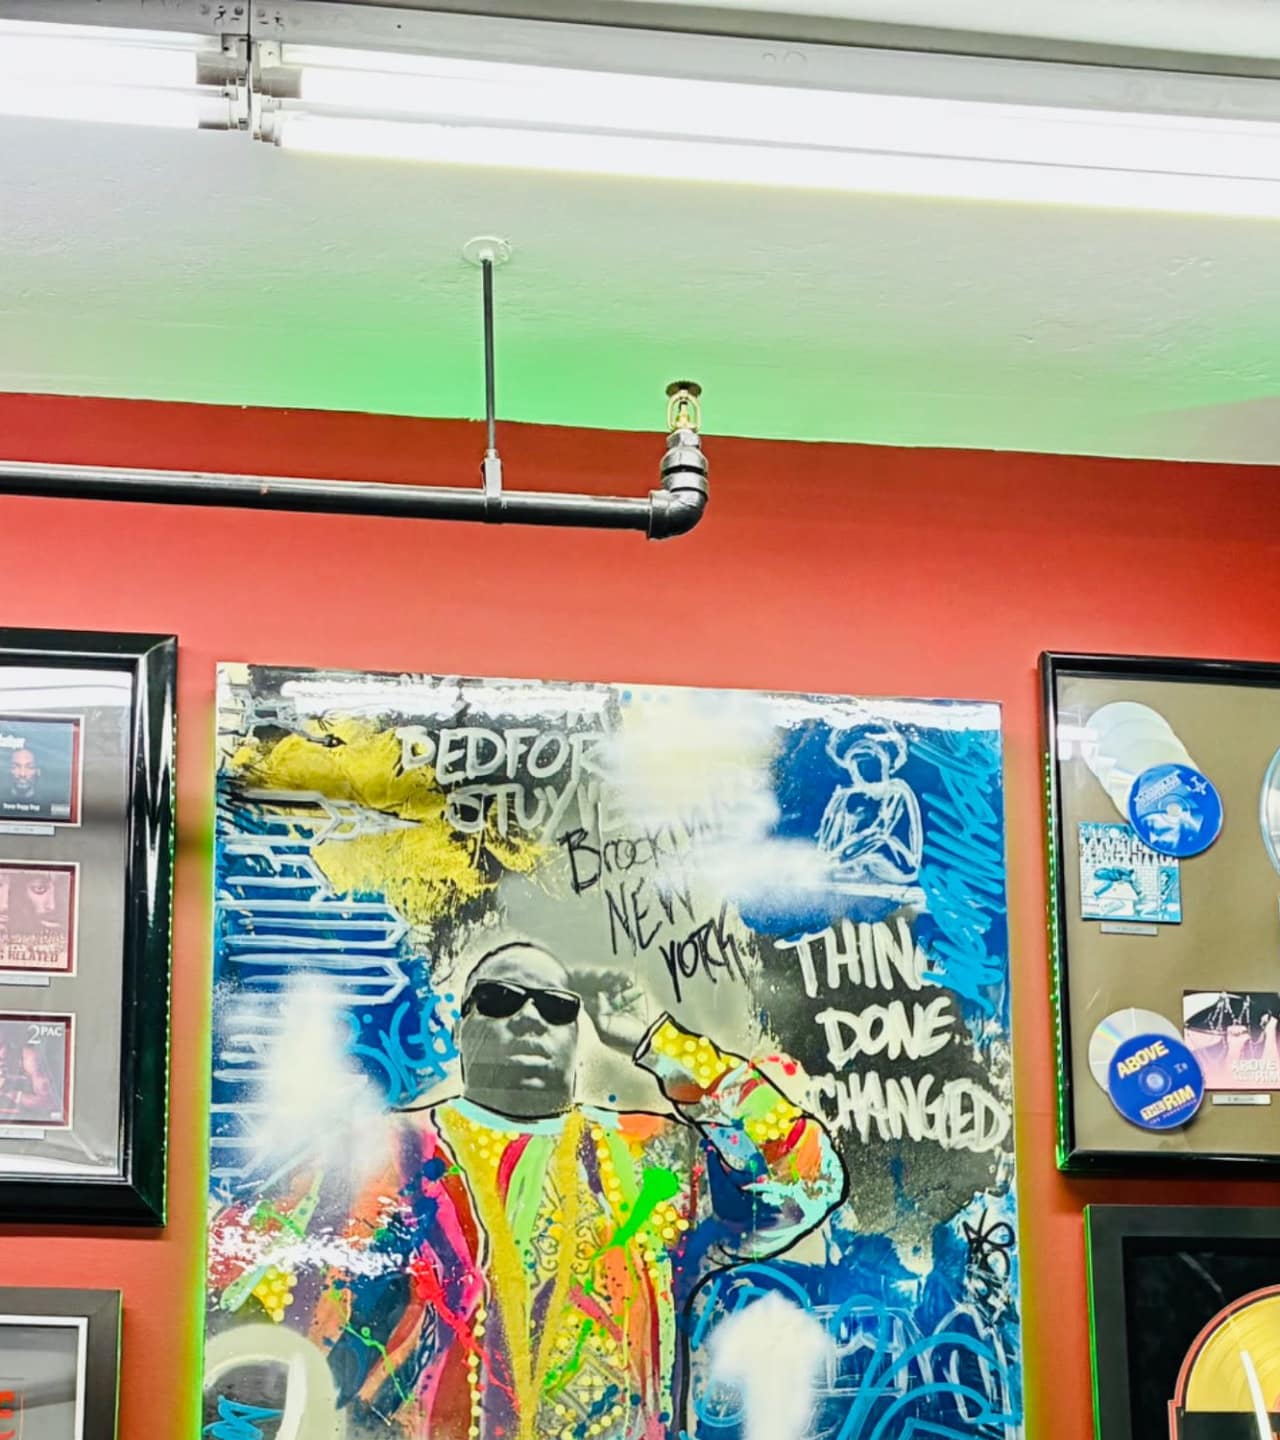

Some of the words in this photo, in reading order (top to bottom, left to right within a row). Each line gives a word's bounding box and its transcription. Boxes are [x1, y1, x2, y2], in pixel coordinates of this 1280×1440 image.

[26, 1023, 63, 1046] 2PAC
[815, 996, 956, 1072] DONE
[1116, 1039, 1170, 1080] ABOVE
[808, 1070, 1013, 1153] CHANGED
[1162, 1084, 1197, 1111] RIM
